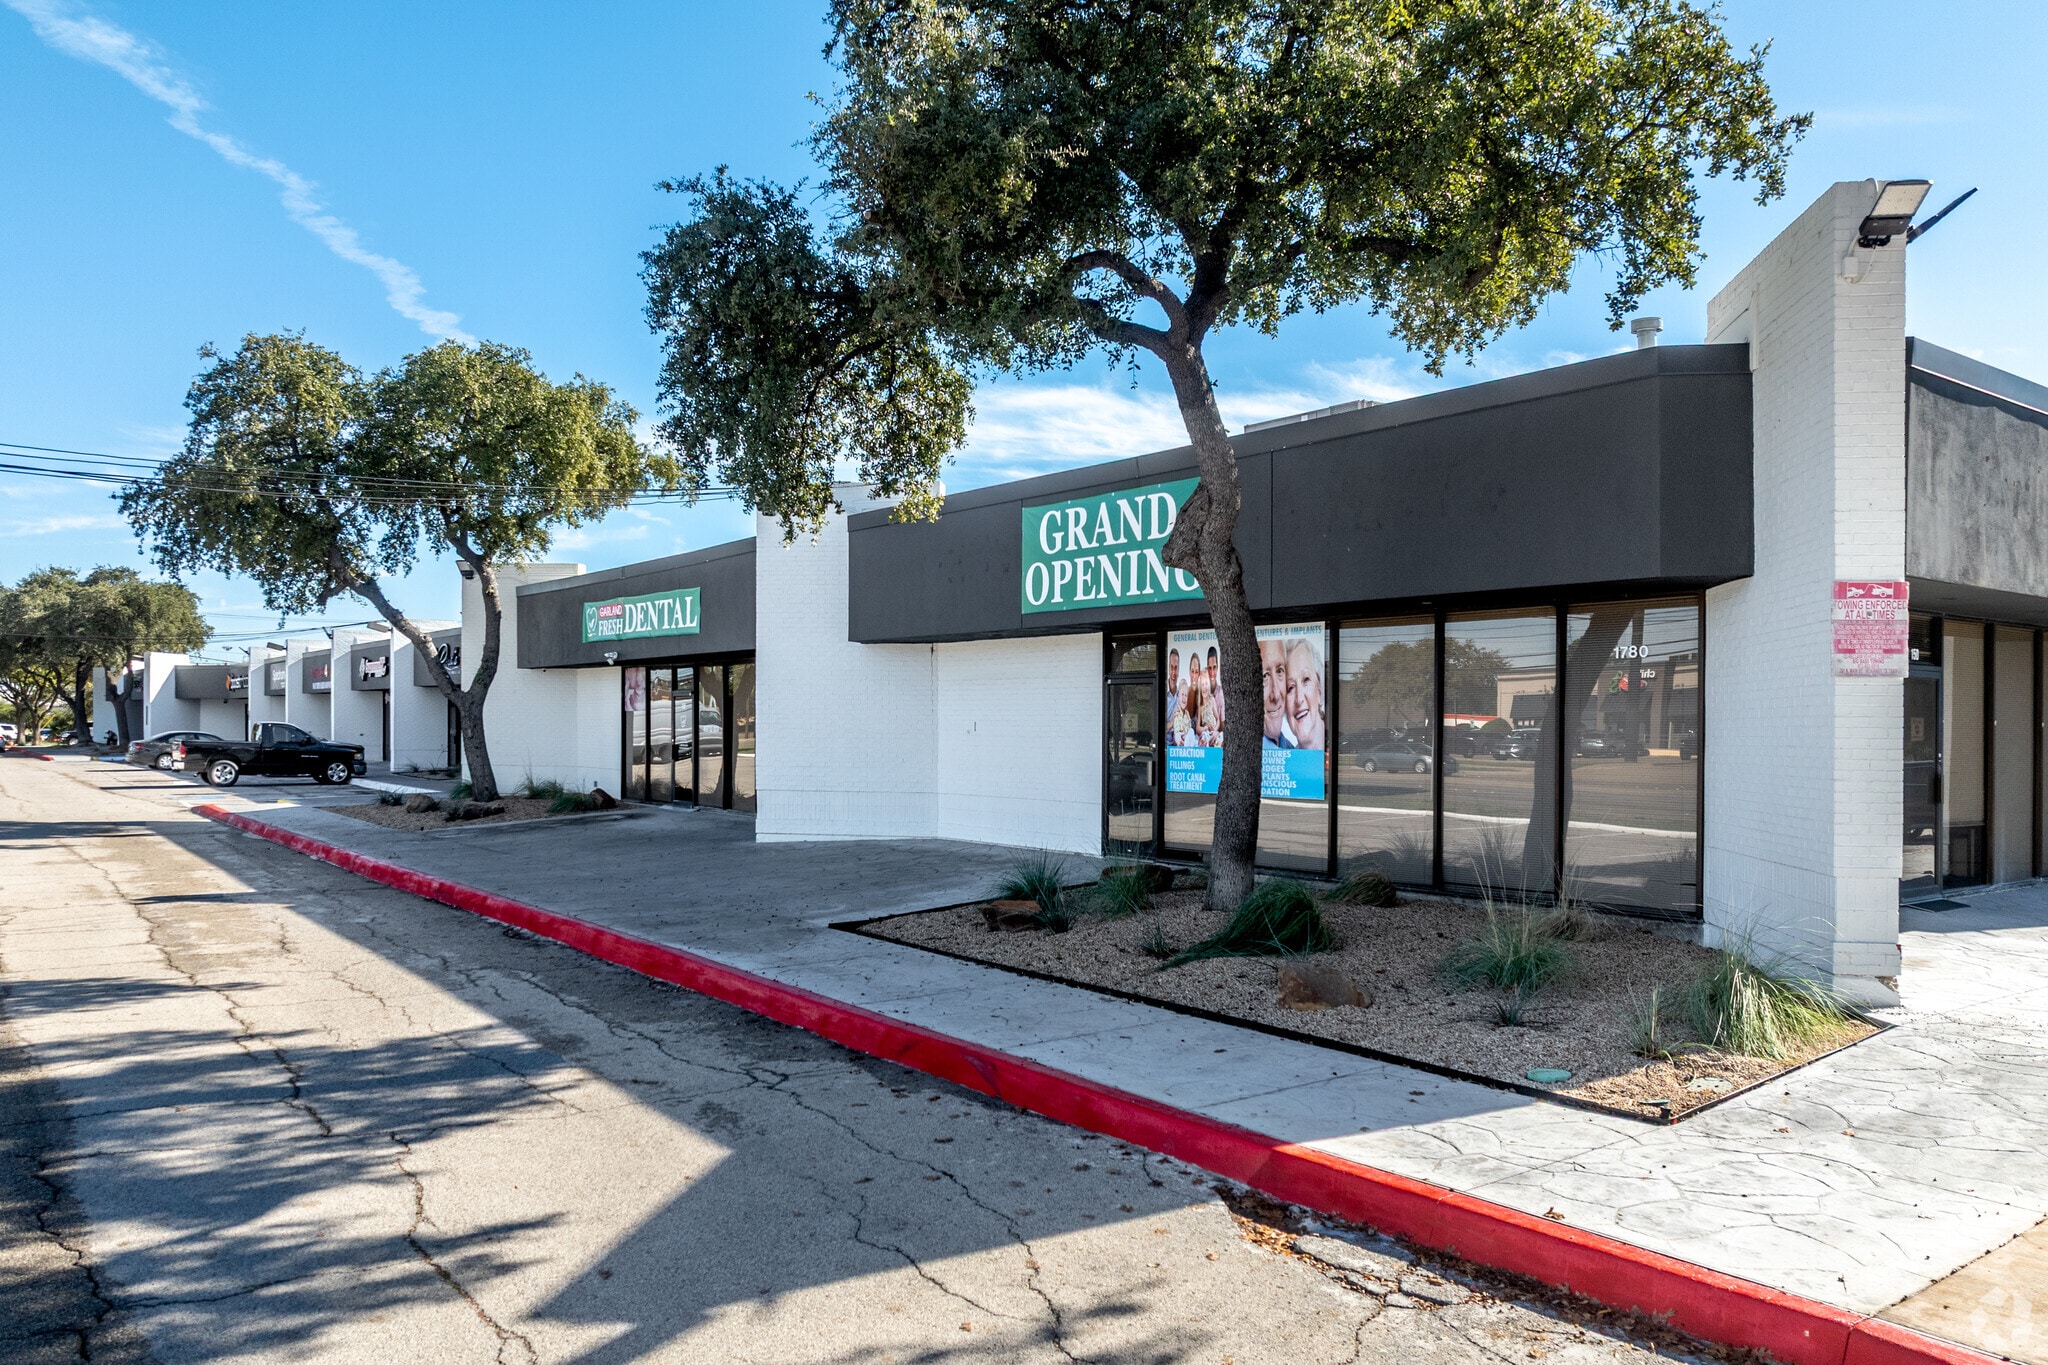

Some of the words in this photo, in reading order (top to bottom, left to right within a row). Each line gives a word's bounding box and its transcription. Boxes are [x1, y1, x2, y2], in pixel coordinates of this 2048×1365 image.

[1039, 492, 1177, 554] GRAND
[1833, 600, 1864, 610] TOWING
[1866, 600, 1907, 610] ENFORCED
[598, 618, 624, 636] FRESH
[624, 596, 698, 633] DENTAL
[599, 605, 623, 617] GARLAND
[1845, 610, 1854, 619] AT
[1872, 610, 1896, 620] TIMES
[1256, 627, 1283, 637] ENTURES
[1284, 627, 1289, 636] &
[1291, 625, 1322, 636] IMPLANTS
[1173, 632, 1197, 642] GENERAL
[1613, 645, 1649, 659] 1780
[1169, 748, 1205, 758] EXTRACTION
[1262, 750, 1291, 758] NTURES
[1169, 760, 1195, 770] FILLINGS
[1262, 757, 1287, 765] OWNS
[1262, 765, 1286, 773] IDGES
[1169, 772, 1186, 781] ROOT
[1187, 772, 1206, 783] CANAL
[1262, 772, 1290, 781] PLANTS
[1169, 780, 1203, 791] TREATMENT
[1261, 780, 1297, 788] NSCIOUS
[1261, 788, 1290, 797] DATION
